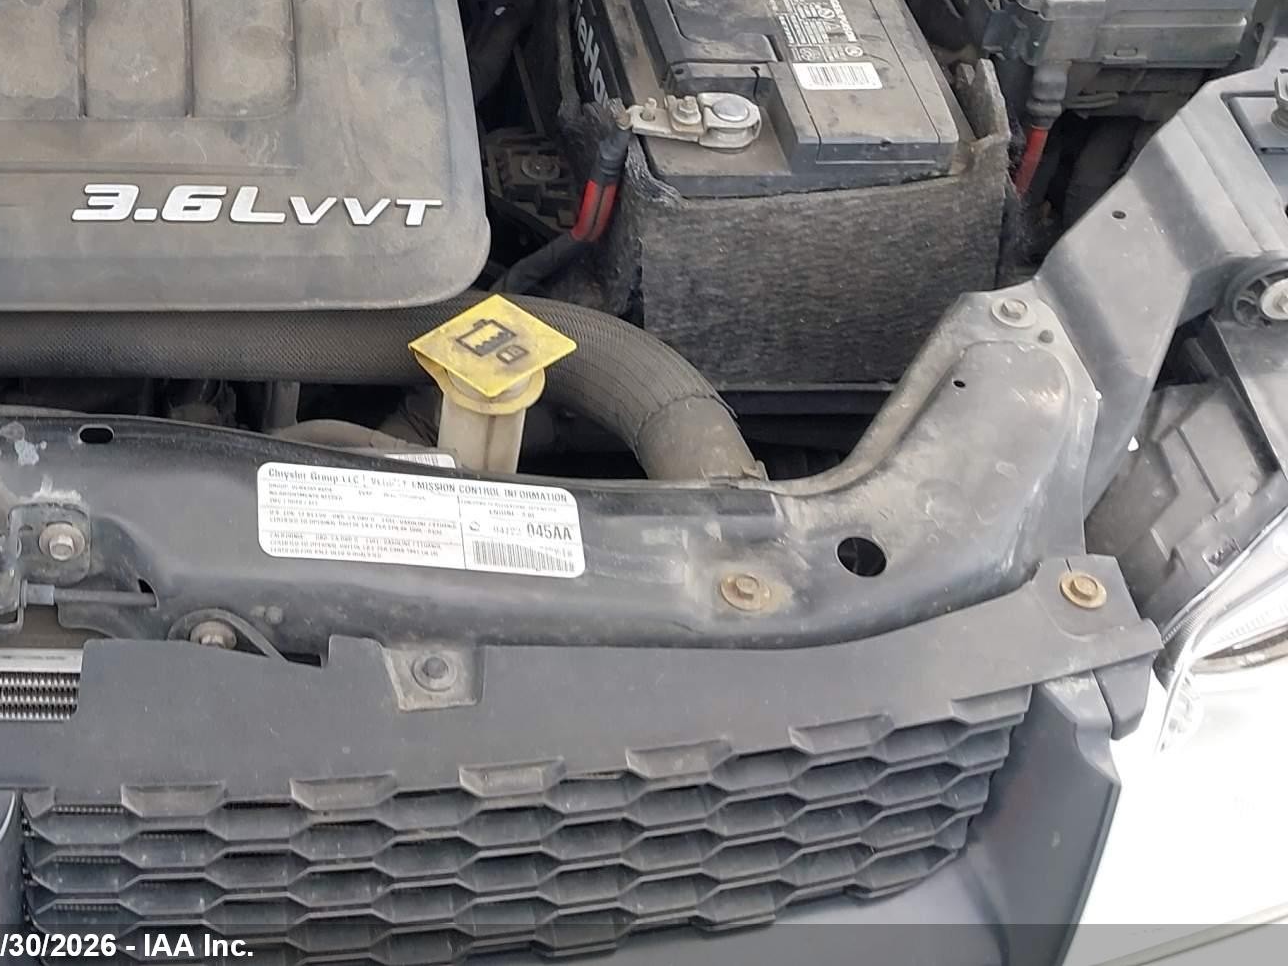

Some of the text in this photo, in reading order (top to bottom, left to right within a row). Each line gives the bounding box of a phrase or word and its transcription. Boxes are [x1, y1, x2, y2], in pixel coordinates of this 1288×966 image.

[71, 183, 443, 226] 3.6L VVT
[268, 467, 307, 481] Chrysler
[309, 470, 340, 486] Group
[411, 479, 456, 493] EMISSION
[458, 484, 500, 498] CONTROL
[503, 488, 568, 503] INFORMATION
[526, 522, 573, 541] 045AA
